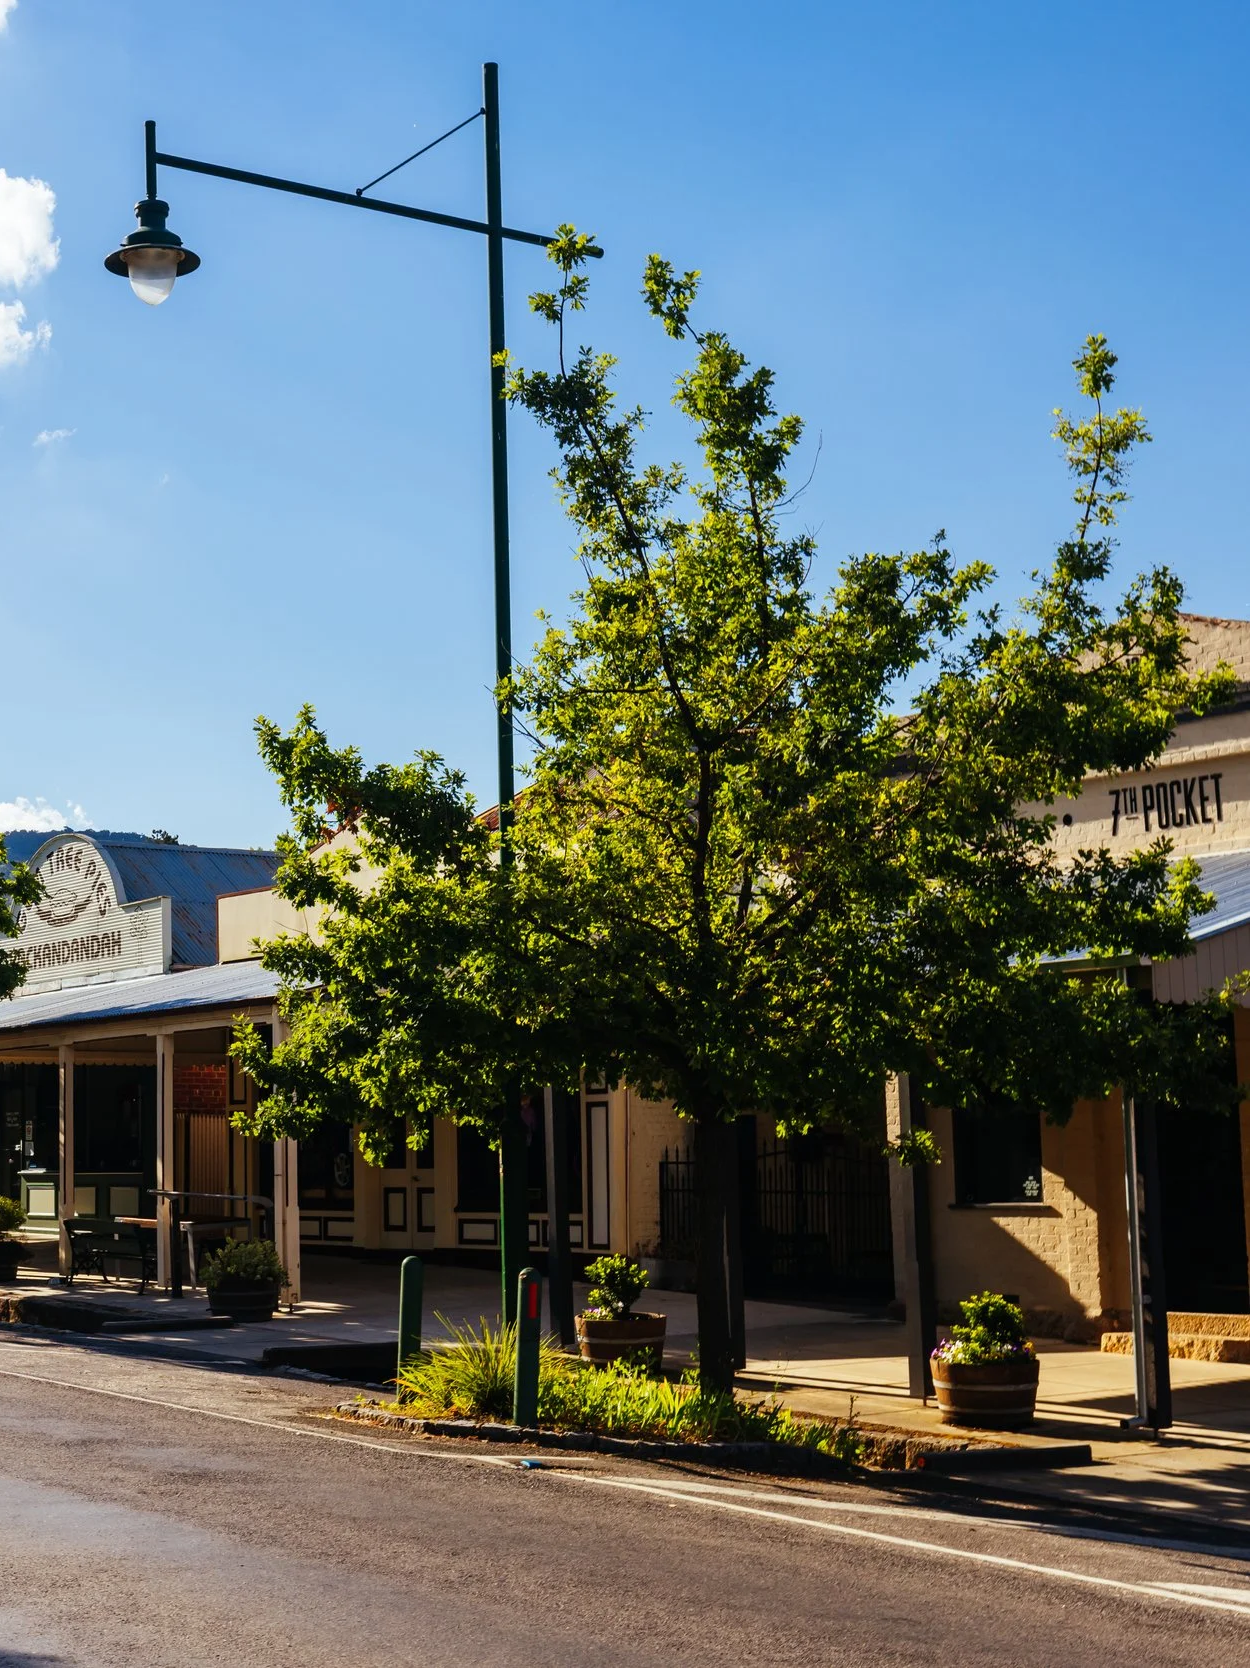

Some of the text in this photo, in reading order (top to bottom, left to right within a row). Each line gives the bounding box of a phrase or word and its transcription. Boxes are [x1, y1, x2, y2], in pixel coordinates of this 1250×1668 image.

[1108, 773, 1223, 836] 7TH POCKET
[46, 846, 84, 876] TREE
